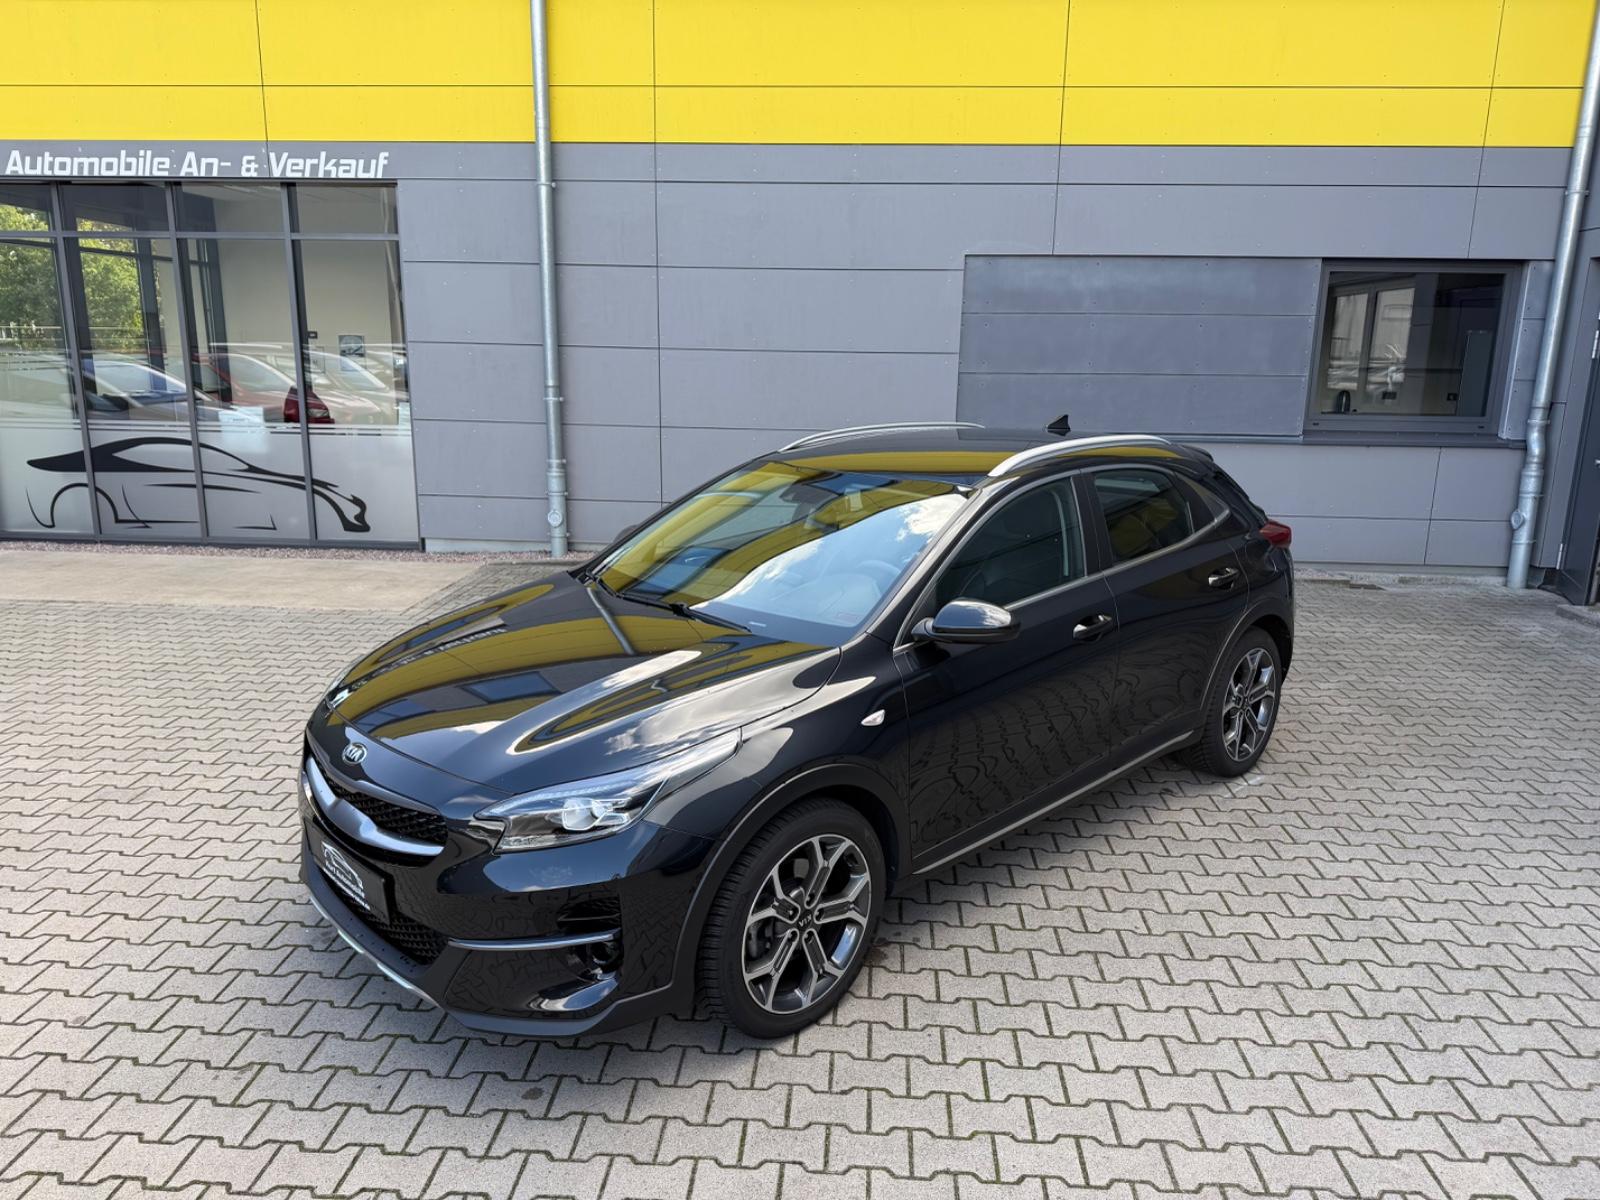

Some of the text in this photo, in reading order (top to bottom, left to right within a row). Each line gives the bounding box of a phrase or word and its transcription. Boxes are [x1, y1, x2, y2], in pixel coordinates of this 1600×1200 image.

[5, 150, 390, 179] Automobile An- & Verkauf
